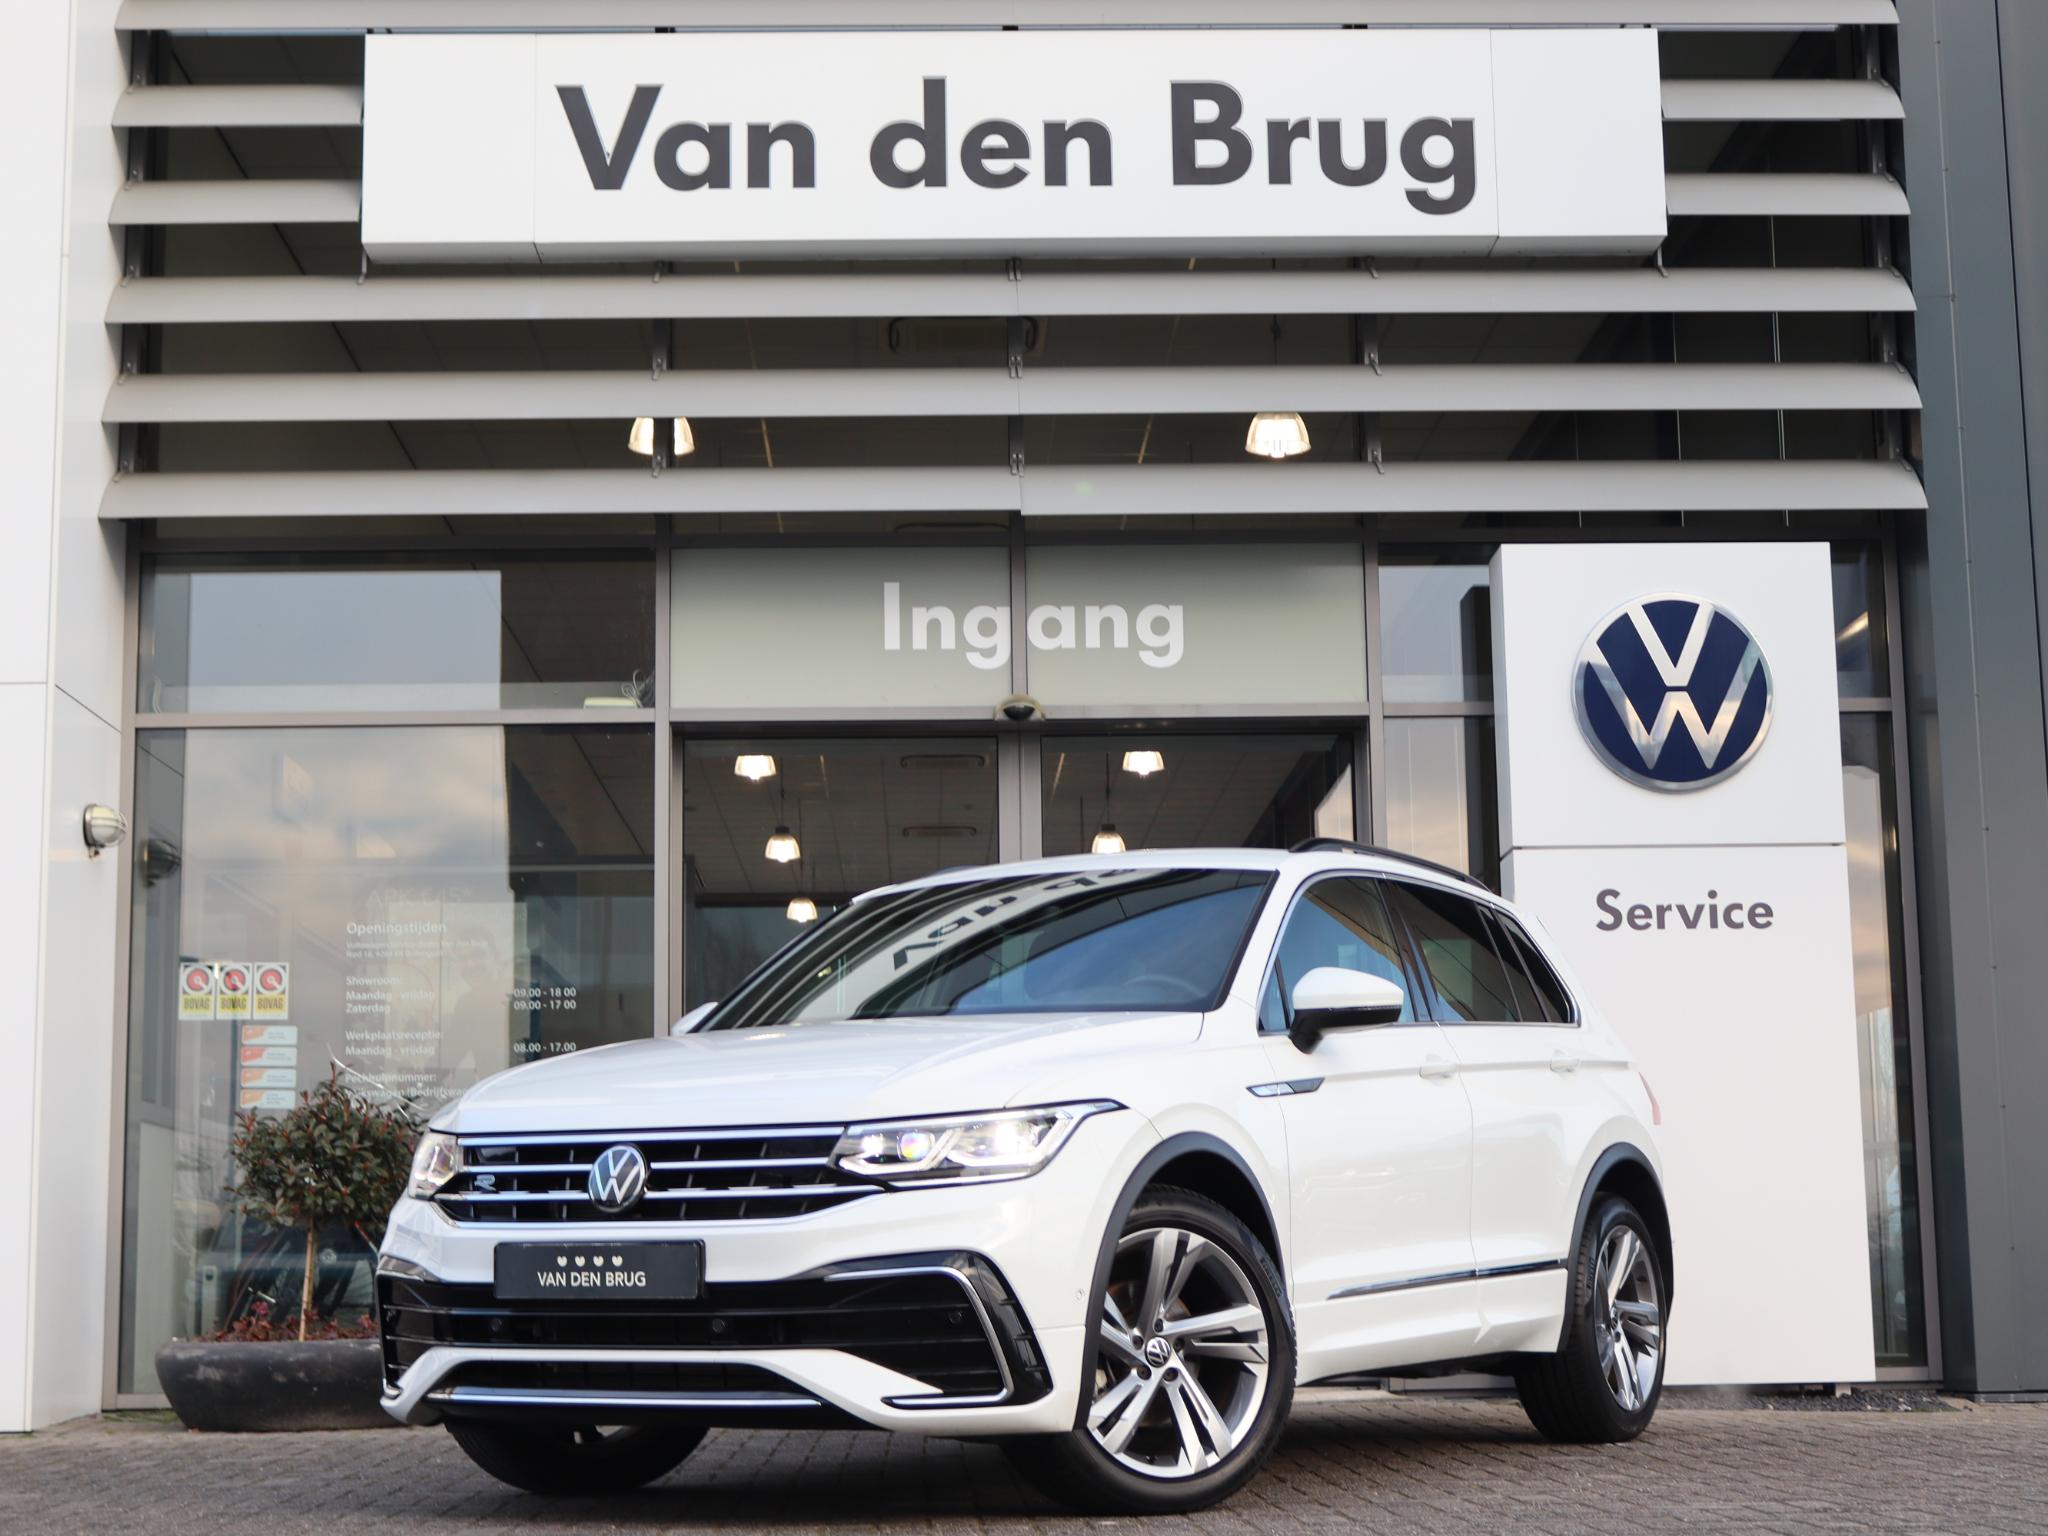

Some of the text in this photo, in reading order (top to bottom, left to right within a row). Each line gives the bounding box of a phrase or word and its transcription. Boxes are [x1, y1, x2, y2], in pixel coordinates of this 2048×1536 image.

[555, 77, 1477, 216] Van den Brug
[883, 581, 1185, 670] Ingang
[1595, 888, 1775, 932] Service
[345, 921, 447, 937] Openingstijden
[345, 991, 393, 1003] Maandag
[513, 987, 542, 999] 09.00
[183, 997, 210, 1011] BOVAG
[220, 997, 247, 1011] BOVAG
[257, 997, 284, 1011] BOVAG
[345, 1003, 391, 1015] Zaterdag
[513, 1000, 542, 1011] 09.00
[345, 1045, 393, 1059] Maandag
[400, 1045, 436, 1059] vrijdag
[513, 1042, 542, 1053] 08.00
[550, 1041, 577, 1053] 17.00
[537, 1270, 647, 1287] VAN DEN BRUG
